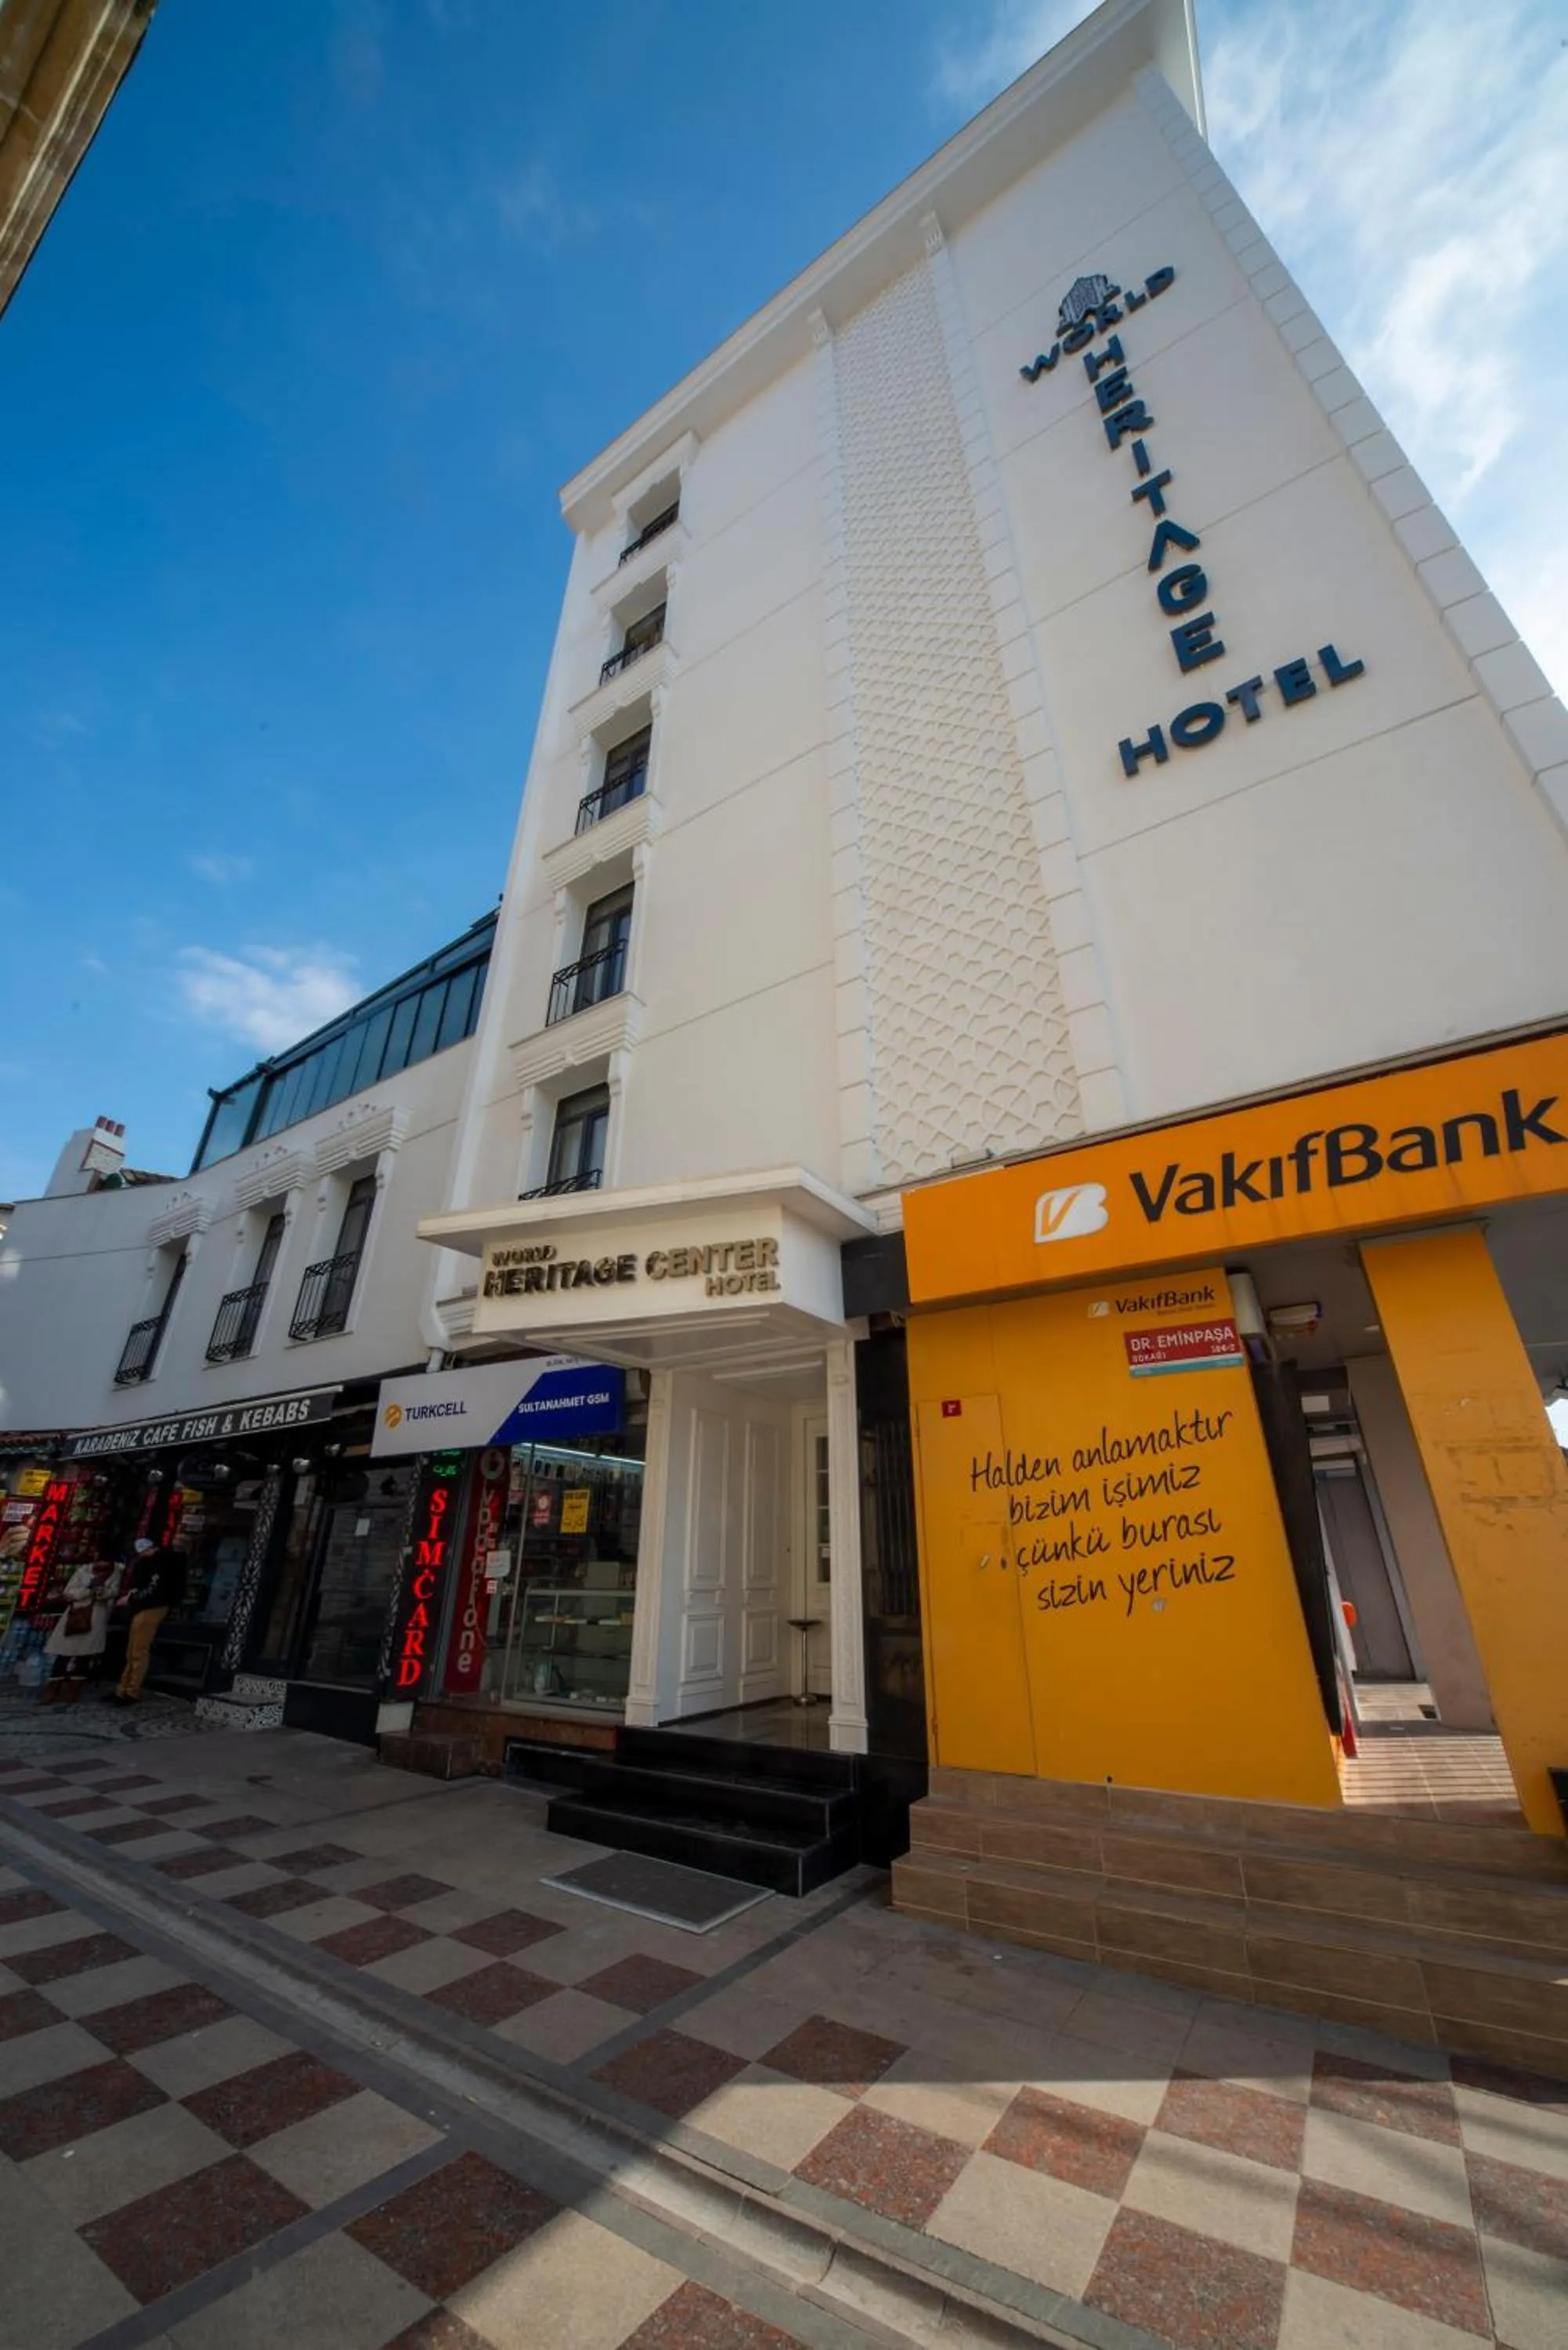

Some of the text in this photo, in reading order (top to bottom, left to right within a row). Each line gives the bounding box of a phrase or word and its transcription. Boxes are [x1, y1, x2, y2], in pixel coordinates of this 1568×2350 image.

[1019, 265, 1176, 383] WORLD
[1083, 334, 1226, 674] HERITAGE
[1118, 643, 1364, 777] HOTEL
[1129, 1088, 1568, 1224] VakıfBank
[483, 1236, 779, 1297] HERITAGE CENTER
[492, 1244, 558, 1267] WORLD
[705, 1270, 781, 1297] HOTEL
[1115, 1285, 1216, 1314] VakıfBank
[1130, 1326, 1234, 1351] DR. EMİNPAŞA
[143, 1423, 179, 1445] CAFE
[182, 1415, 219, 1439] FISH
[222, 1413, 233, 1433] &
[239, 1399, 312, 1430] KEBABS
[405, 1401, 468, 1422] TURKCELL
[518, 1392, 611, 1414] SULTANAHMET GSM
[970, 1408, 1234, 1492] Halden anlamaktır
[1009, 1462, 1201, 1526] bizim işimiz
[18, 1482, 68, 1609] MARKET
[1017, 1508, 1222, 1578] çünkü burası
[1037, 1552, 1236, 1618] sizin yeriniz
